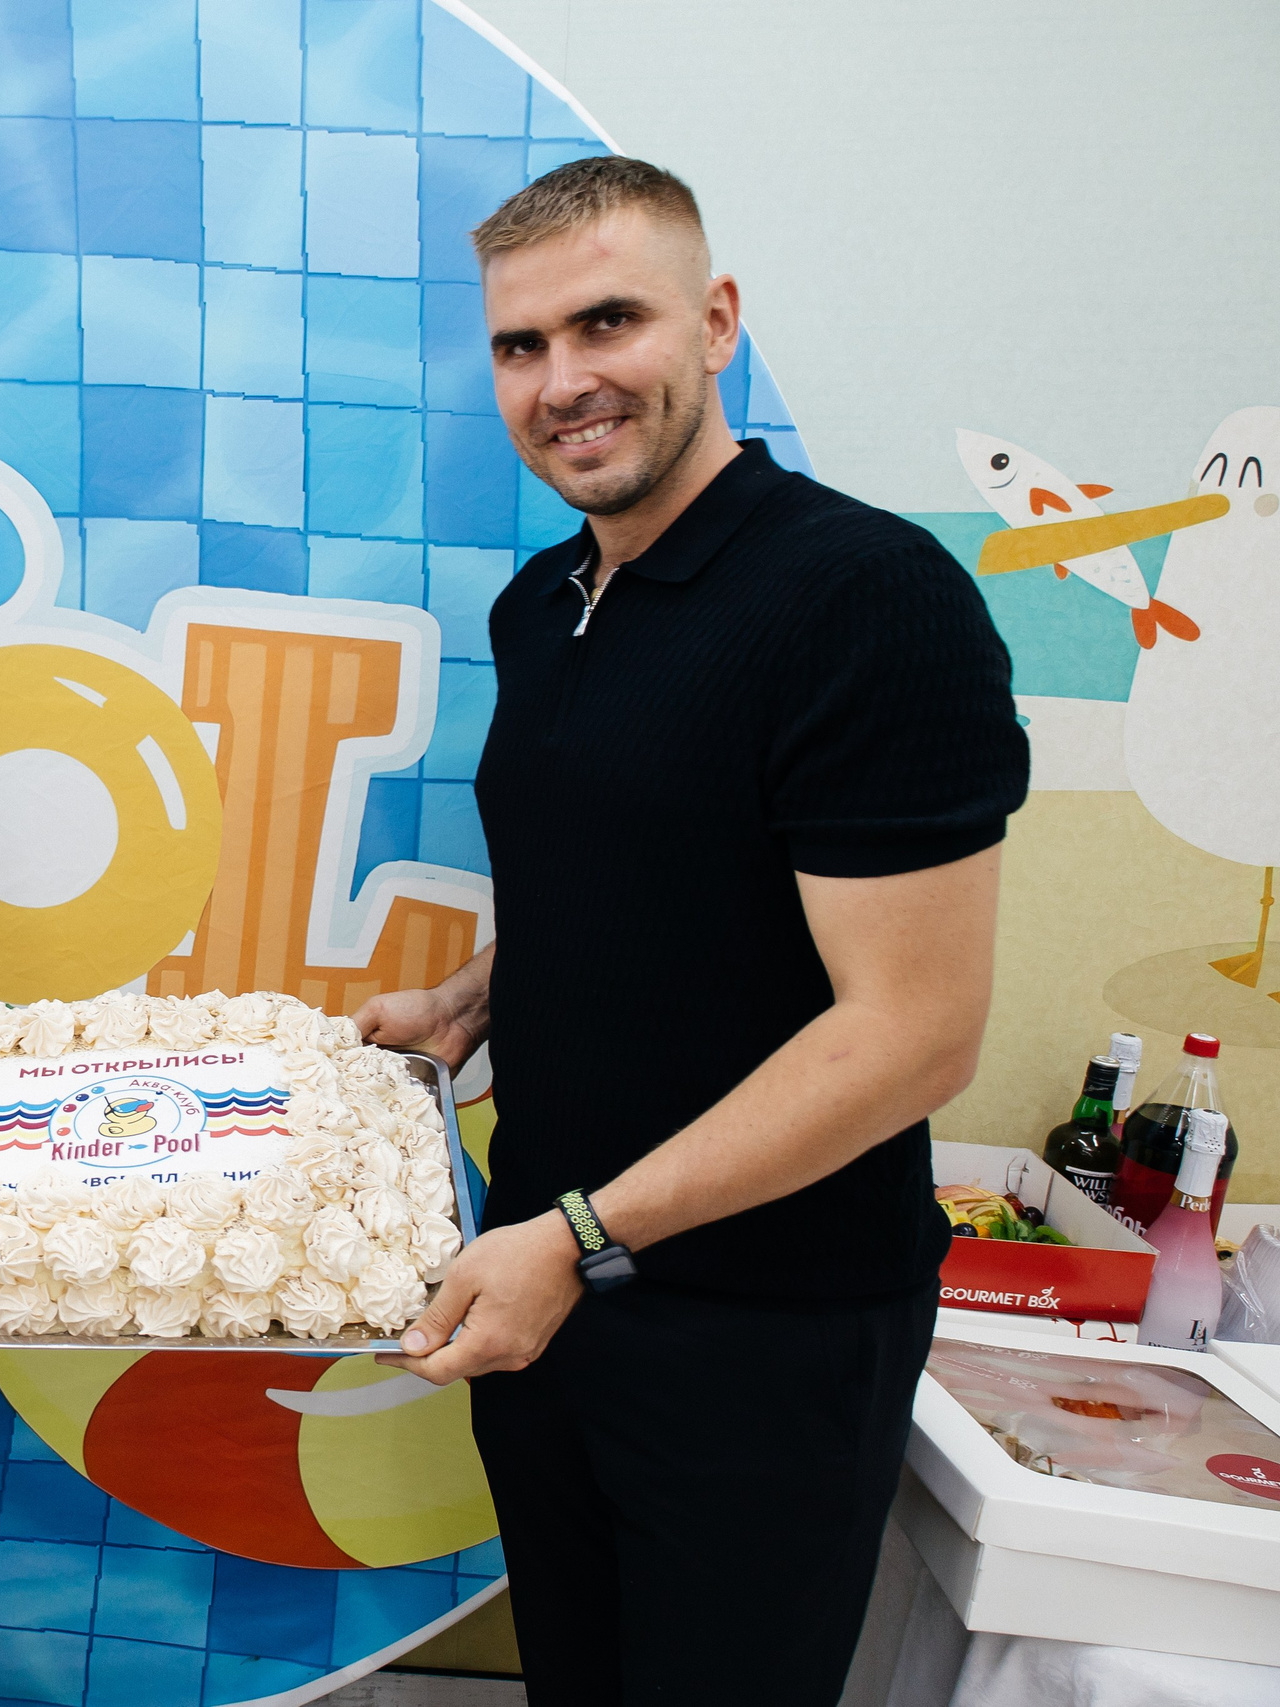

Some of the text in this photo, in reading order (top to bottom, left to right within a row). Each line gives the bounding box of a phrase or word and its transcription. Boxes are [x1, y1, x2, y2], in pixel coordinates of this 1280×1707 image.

[19, 1052, 244, 1079] МЫ ОТКРЫЛИСЬ!
[129, 1079, 201, 1116] Аква-клуб
[51, 1133, 202, 1161] Kinder Pool
[1073, 1175, 1108, 1191] WILL
[940, 1286, 1060, 1309] GOURMET BOX
